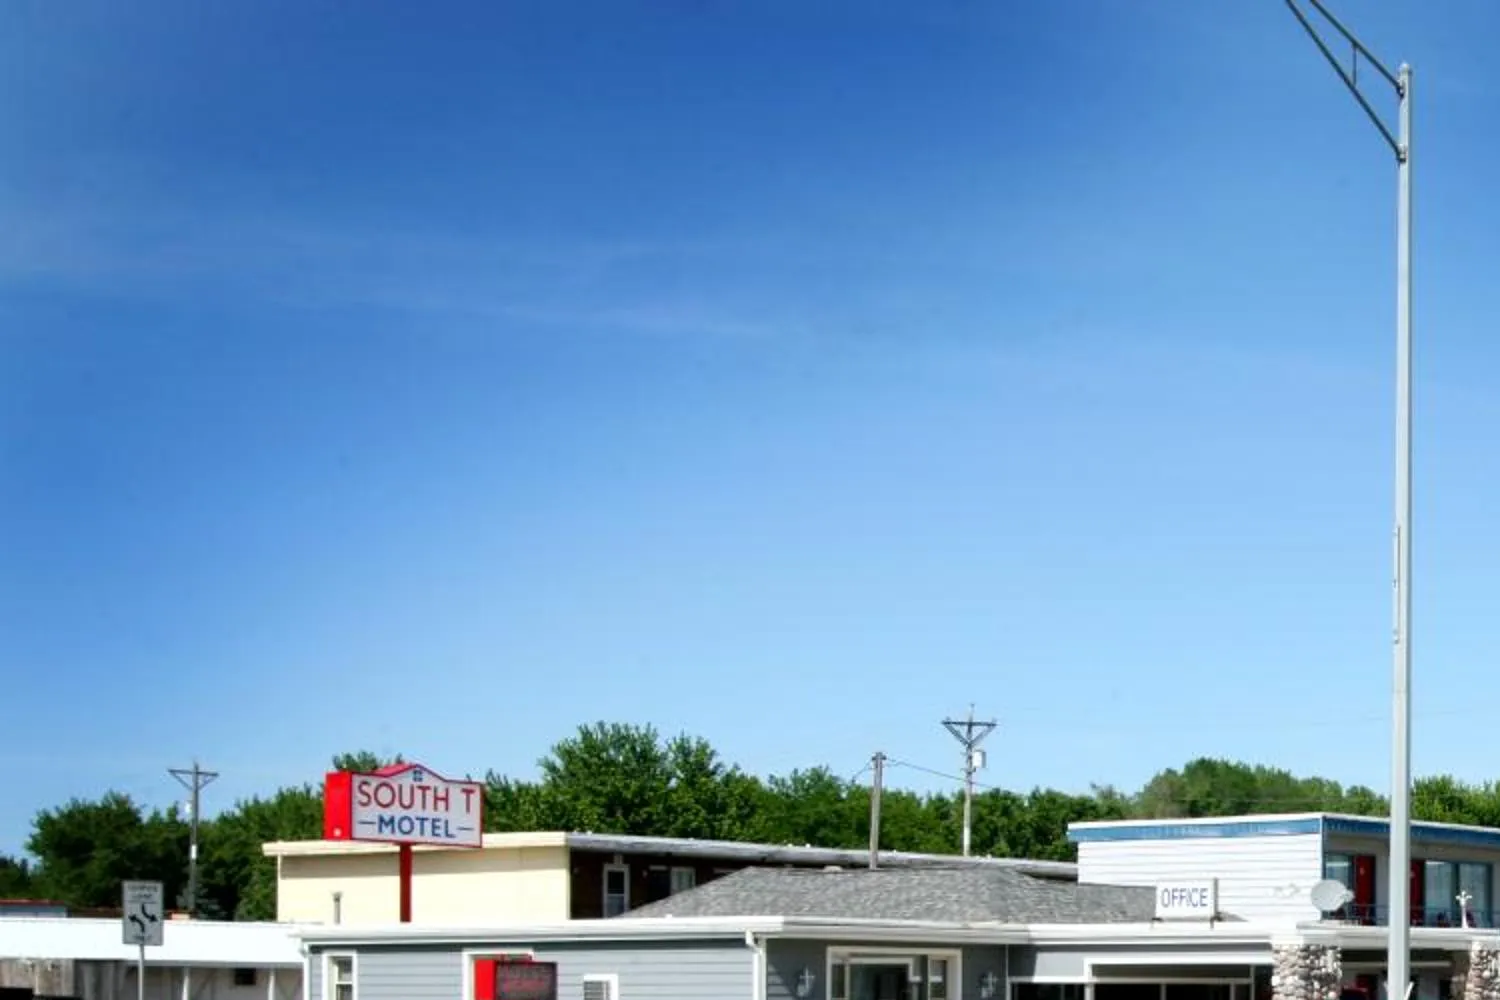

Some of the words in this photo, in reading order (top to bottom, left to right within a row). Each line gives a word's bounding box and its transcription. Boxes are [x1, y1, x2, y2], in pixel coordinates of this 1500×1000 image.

[358, 781, 448, 811] SOUTH
[461, 788, 475, 813] T
[378, 815, 456, 838] MOTEL
[1161, 888, 1208, 908] OFFICE
